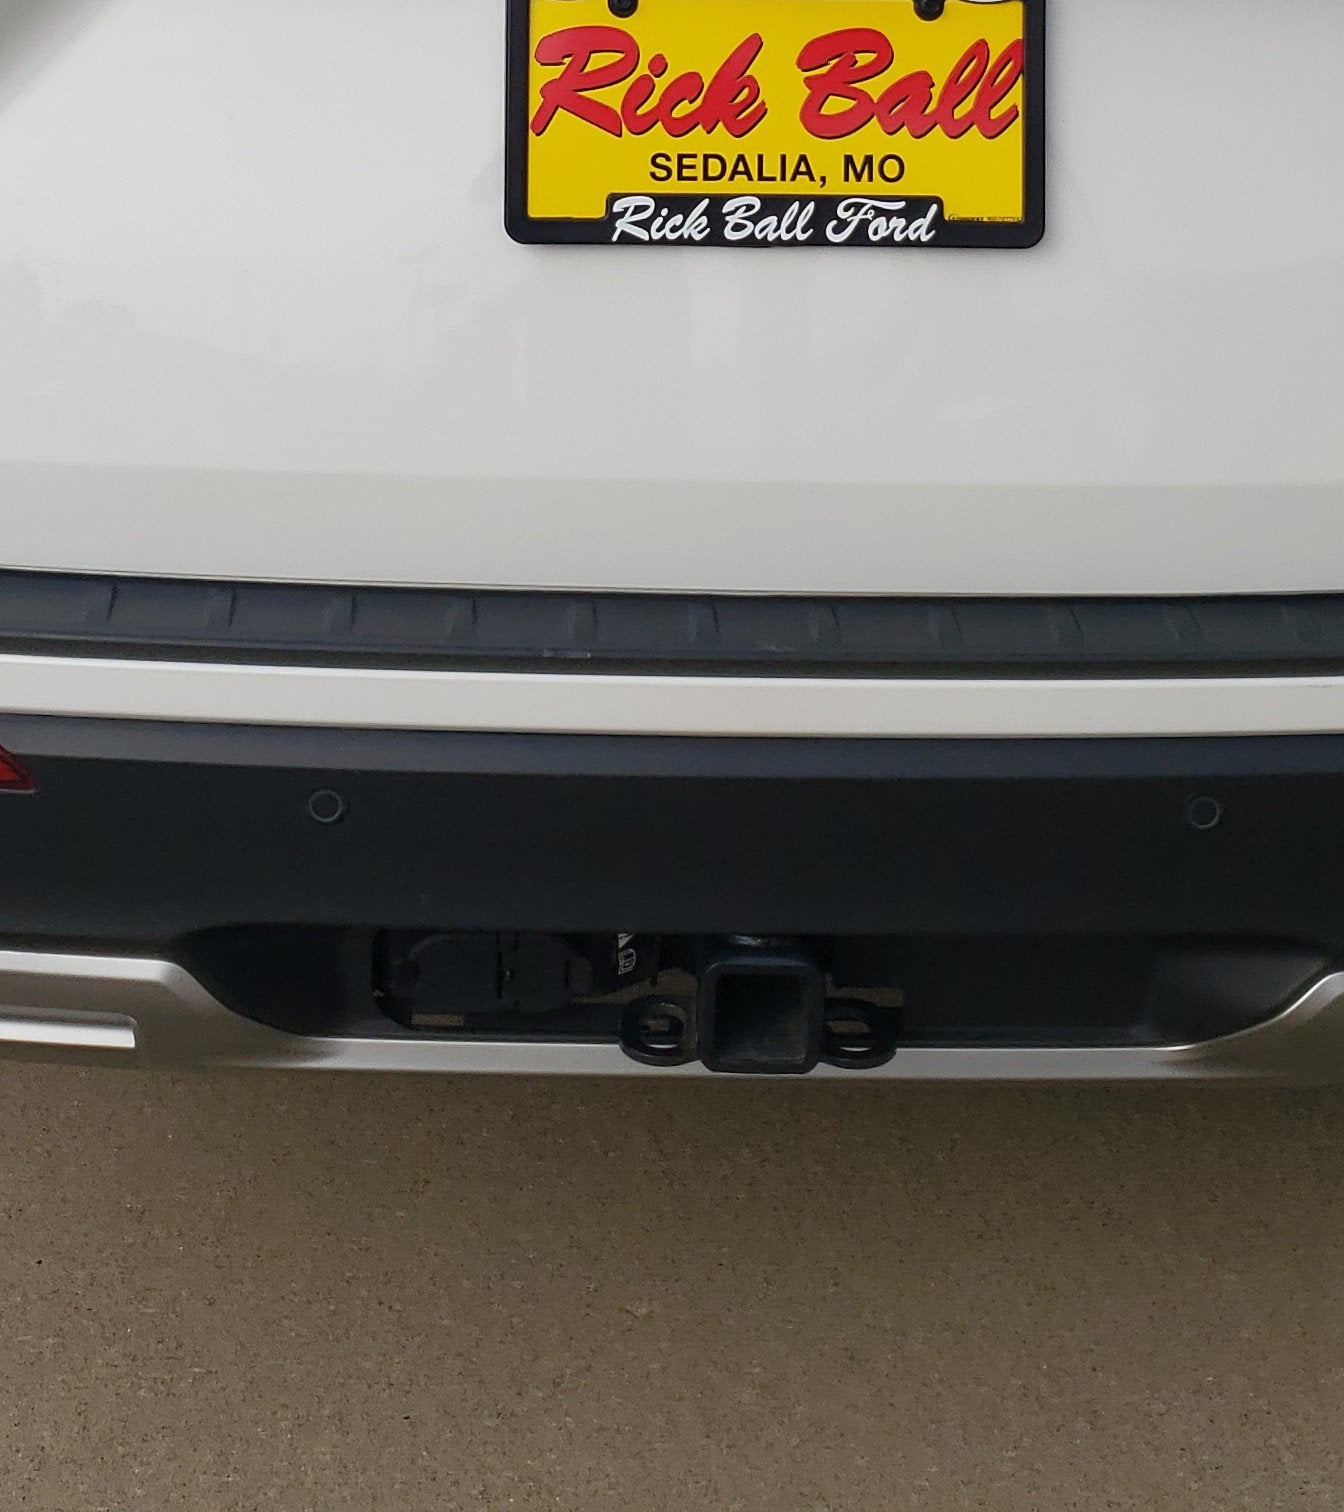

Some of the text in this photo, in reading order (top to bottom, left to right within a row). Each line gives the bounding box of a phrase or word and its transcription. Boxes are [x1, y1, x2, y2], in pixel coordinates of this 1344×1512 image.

[529, 25, 1025, 140] Rick Ball
[648, 151, 906, 189] SEDALIA, MO
[611, 194, 939, 244] Rick Ball Ford
